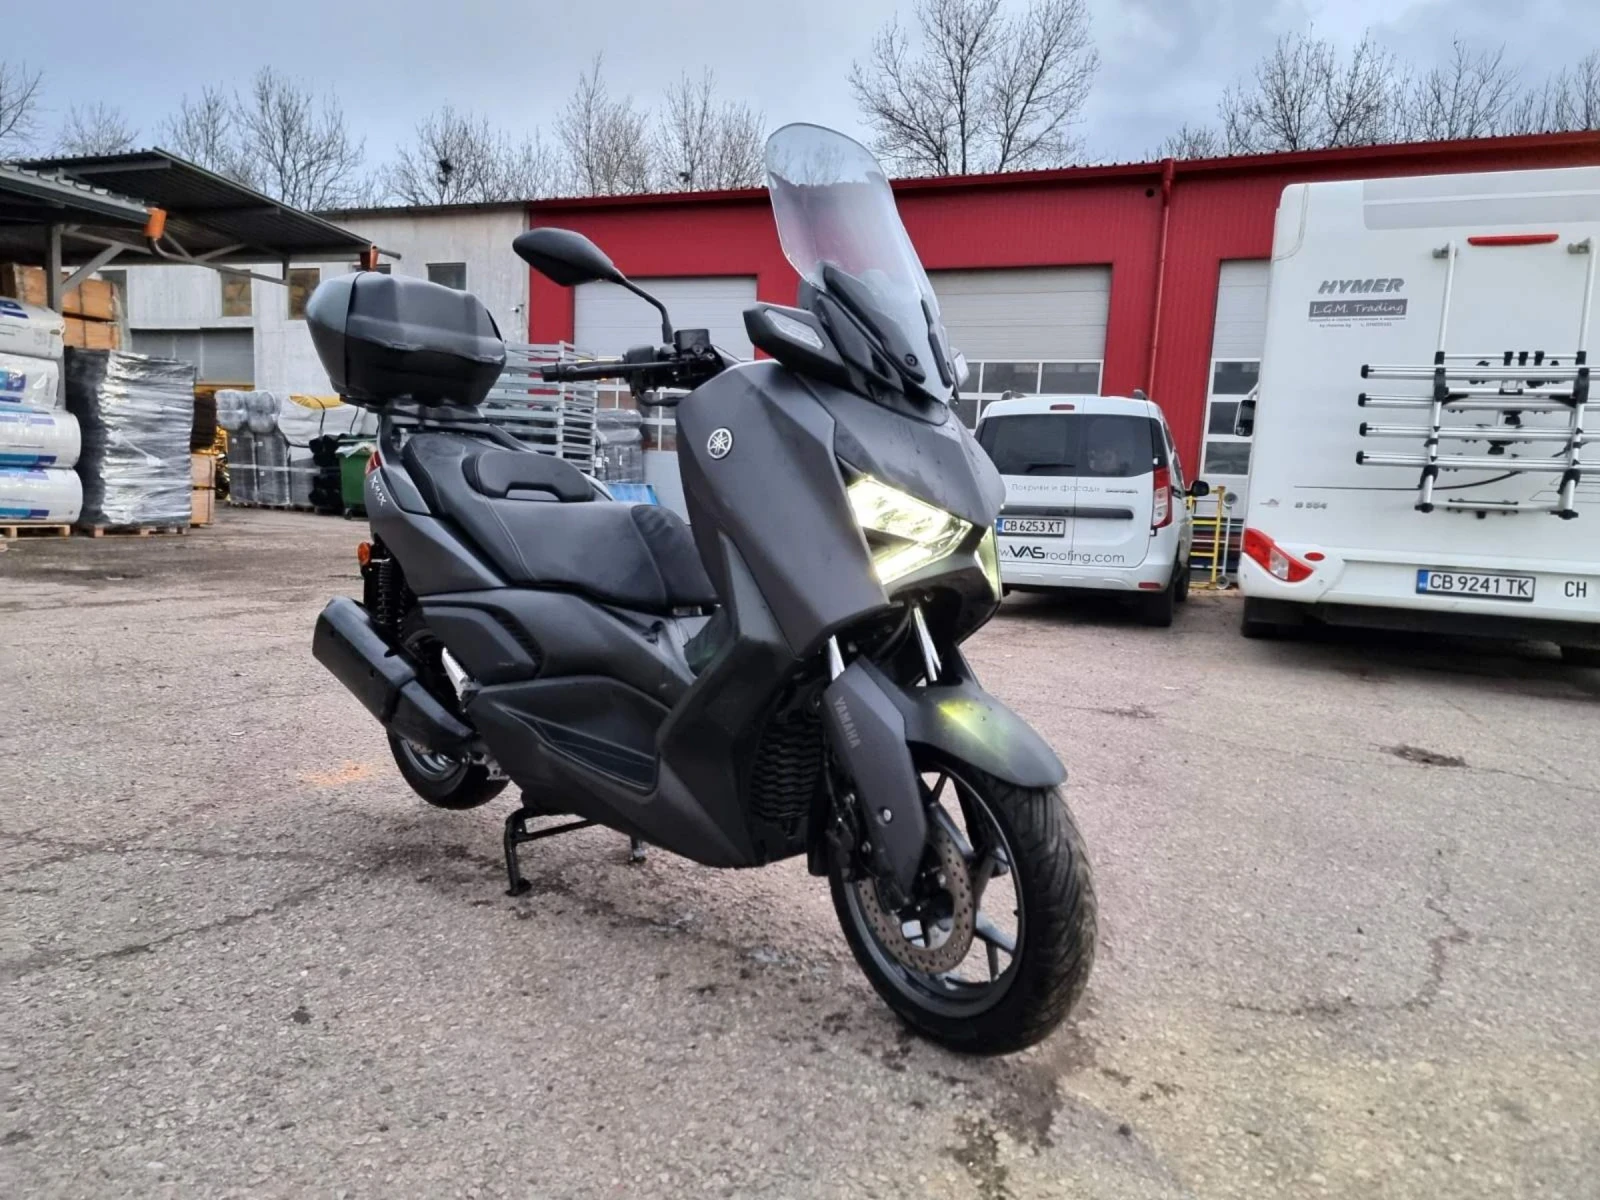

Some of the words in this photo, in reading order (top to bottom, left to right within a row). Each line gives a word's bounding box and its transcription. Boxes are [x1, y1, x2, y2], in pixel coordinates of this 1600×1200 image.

[1318, 278, 1405, 294] HYMER
[1313, 304, 1349, 314] L.G.M.
[1354, 301, 1404, 314] Trading
[1003, 520, 1018, 532] CB
[1019, 520, 1046, 533] 6253
[1047, 521, 1062, 533] XT
[1430, 573, 1454, 590] CB
[1457, 575, 1501, 594] 9241
[1506, 579, 1530, 596] TK
[1564, 581, 1588, 598] CH
[834, 696, 861, 749] YAMAHA
